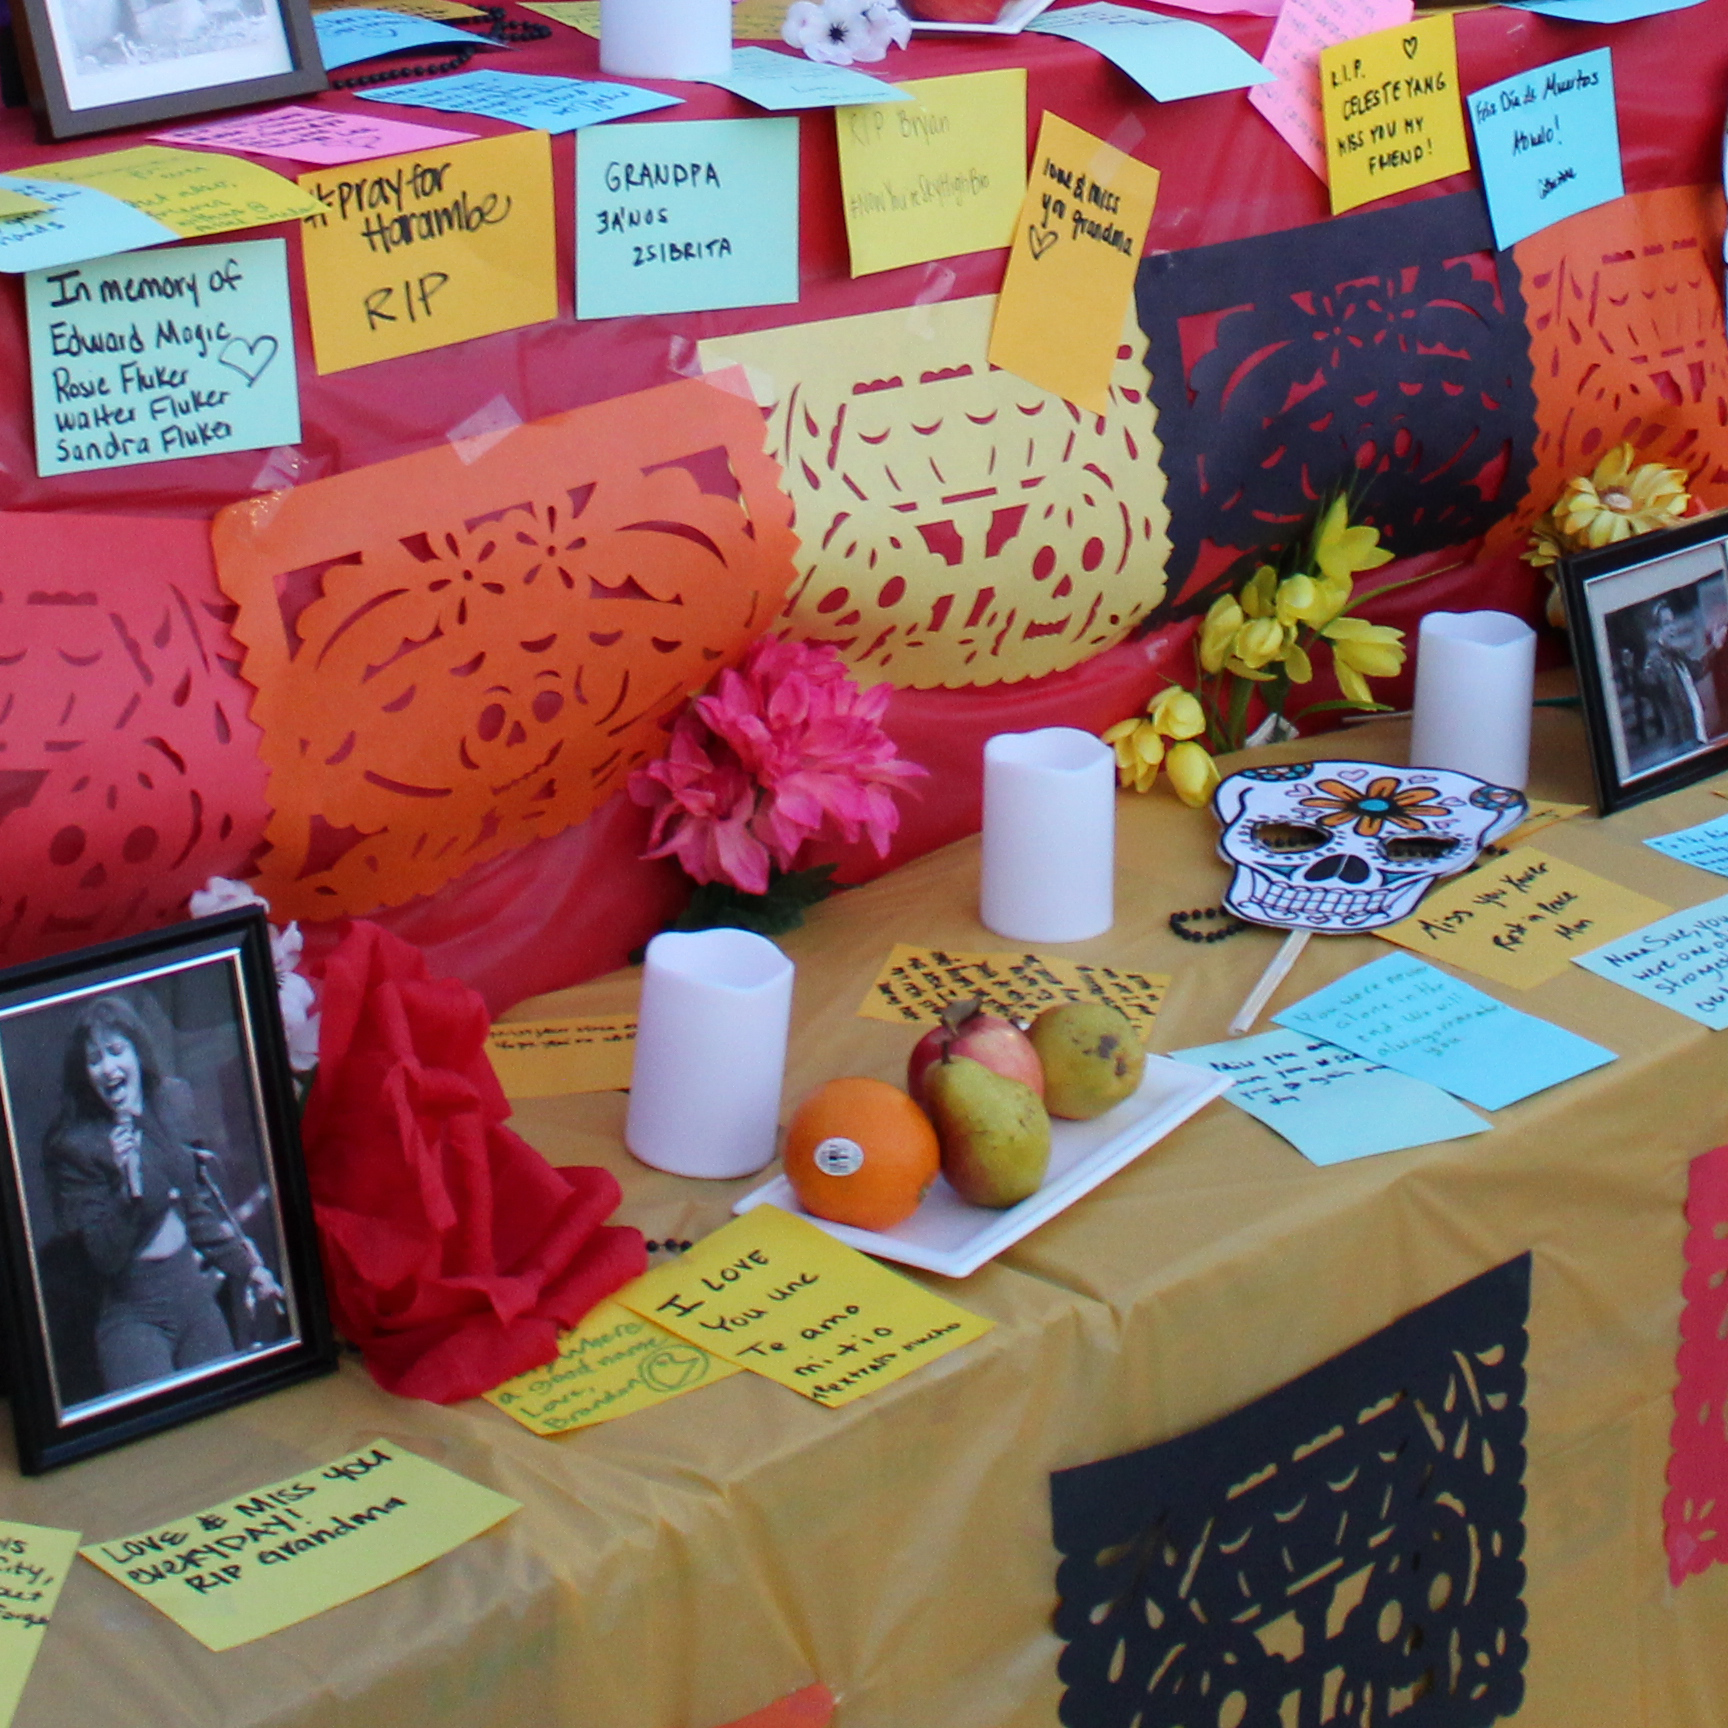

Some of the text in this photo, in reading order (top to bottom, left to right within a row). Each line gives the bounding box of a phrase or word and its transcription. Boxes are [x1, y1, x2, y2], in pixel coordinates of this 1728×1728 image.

[1342, 70, 1448, 121] CELESTE YANG
[897, 110, 951, 146] Bryan
[1369, 119, 1398, 145] YOU
[604, 161, 722, 193] GRANDPA
[360, 190, 512, 254] Harambe
[47, 258, 243, 309] In memory of
[363, 272, 450, 332] RIP
[49, 319, 232, 359] Edward Magic
[51, 360, 190, 405] Rosie Fluker
[148, 389, 232, 421] Fluker
[159, 420, 234, 453] Fluker
[1632, 958, 1676, 981] were
[1677, 944, 1711, 962] one
[656, 1248, 770, 1318] I LOVE
[699, 1308, 768, 1333] You
[736, 1303, 861, 1358] Te amo
[794, 1356, 834, 1378] mi
[101, 1530, 189, 1565] LOVE
[233, 1482, 317, 1519] MISS
[183, 1563, 243, 1596] RIP
